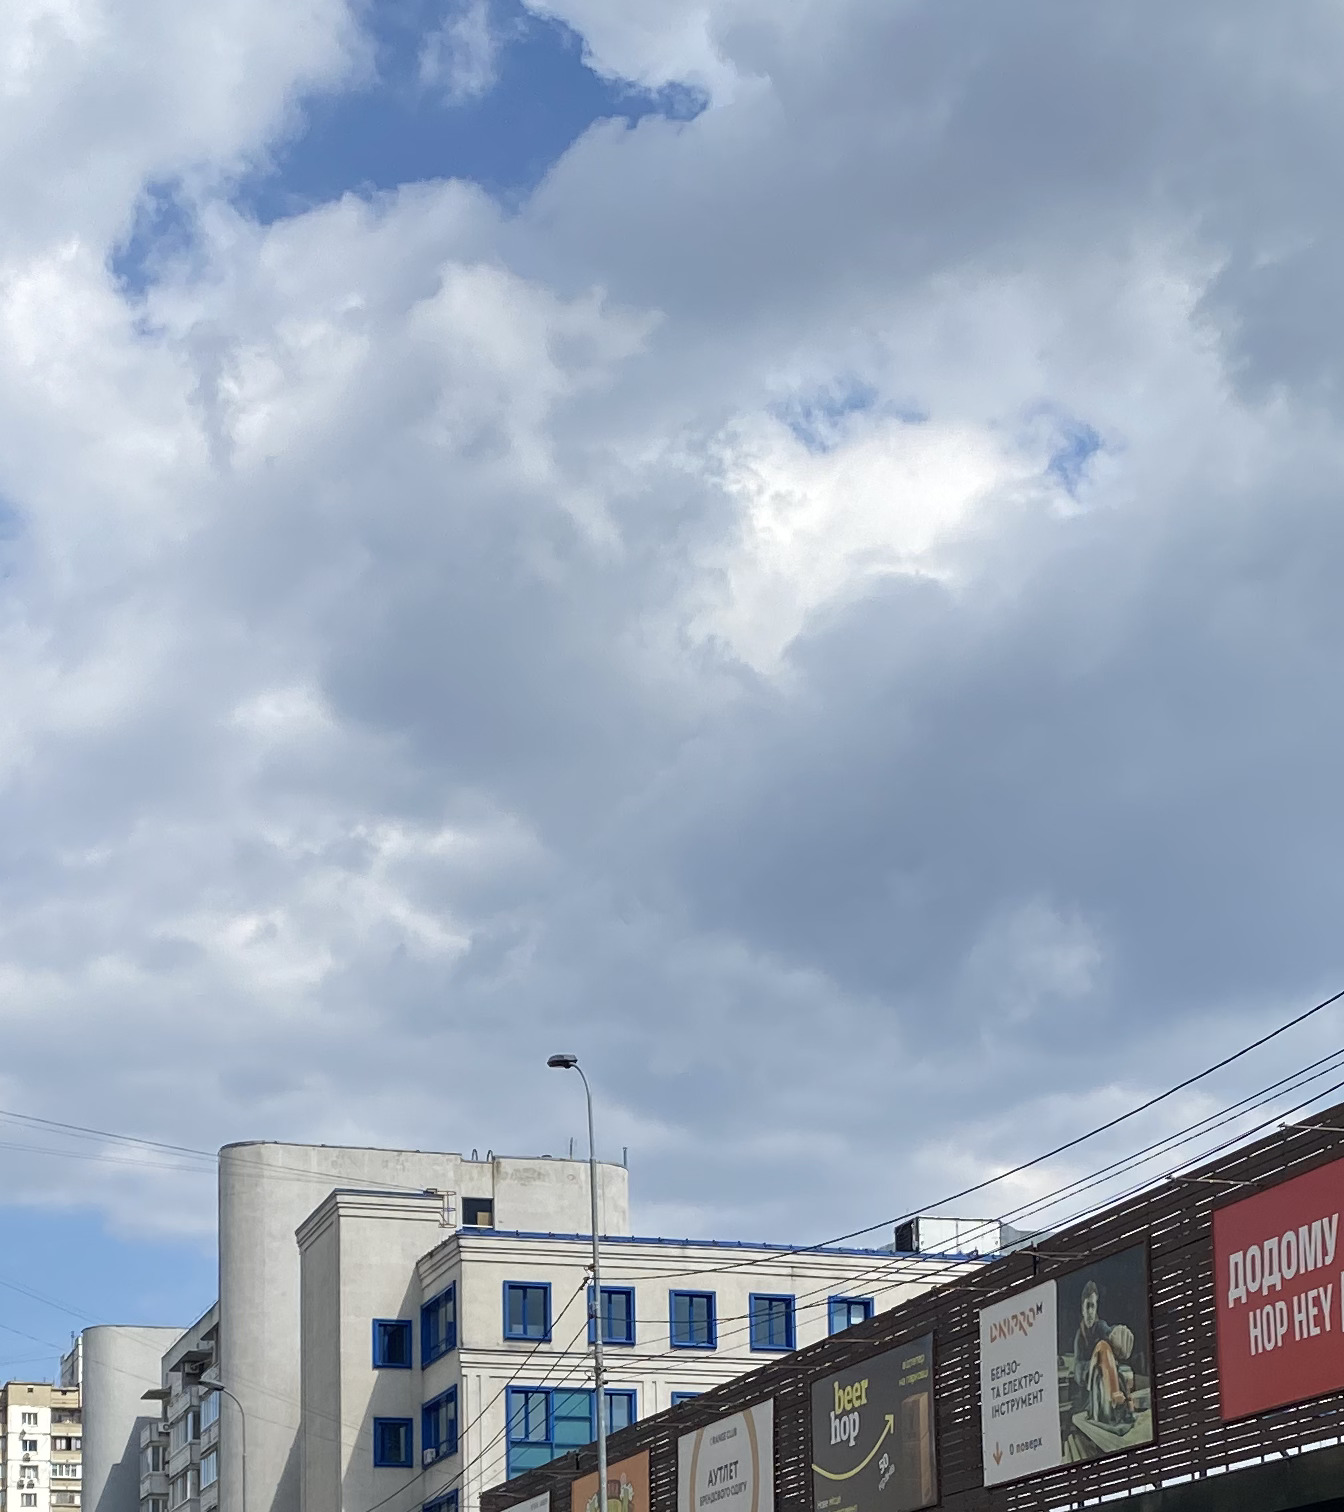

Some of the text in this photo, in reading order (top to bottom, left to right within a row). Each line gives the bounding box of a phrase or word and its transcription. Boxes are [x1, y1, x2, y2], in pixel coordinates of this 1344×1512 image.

[1228, 1213, 1339, 1308] ДОДОМУ
[1248, 1283, 1333, 1356] HOP HEY
[990, 1360, 1021, 1382] БЕНЗО-
[991, 1371, 1043, 1400] ТА ЕЛЕКТРО-
[833, 1378, 869, 1415] beer
[991, 1389, 1044, 1419] ІНСТРУМЕНТ
[830, 1410, 860, 1447] hop
[1016, 1437, 1043, 1452] поверх
[707, 1460, 739, 1488] АУТЛЕТ
